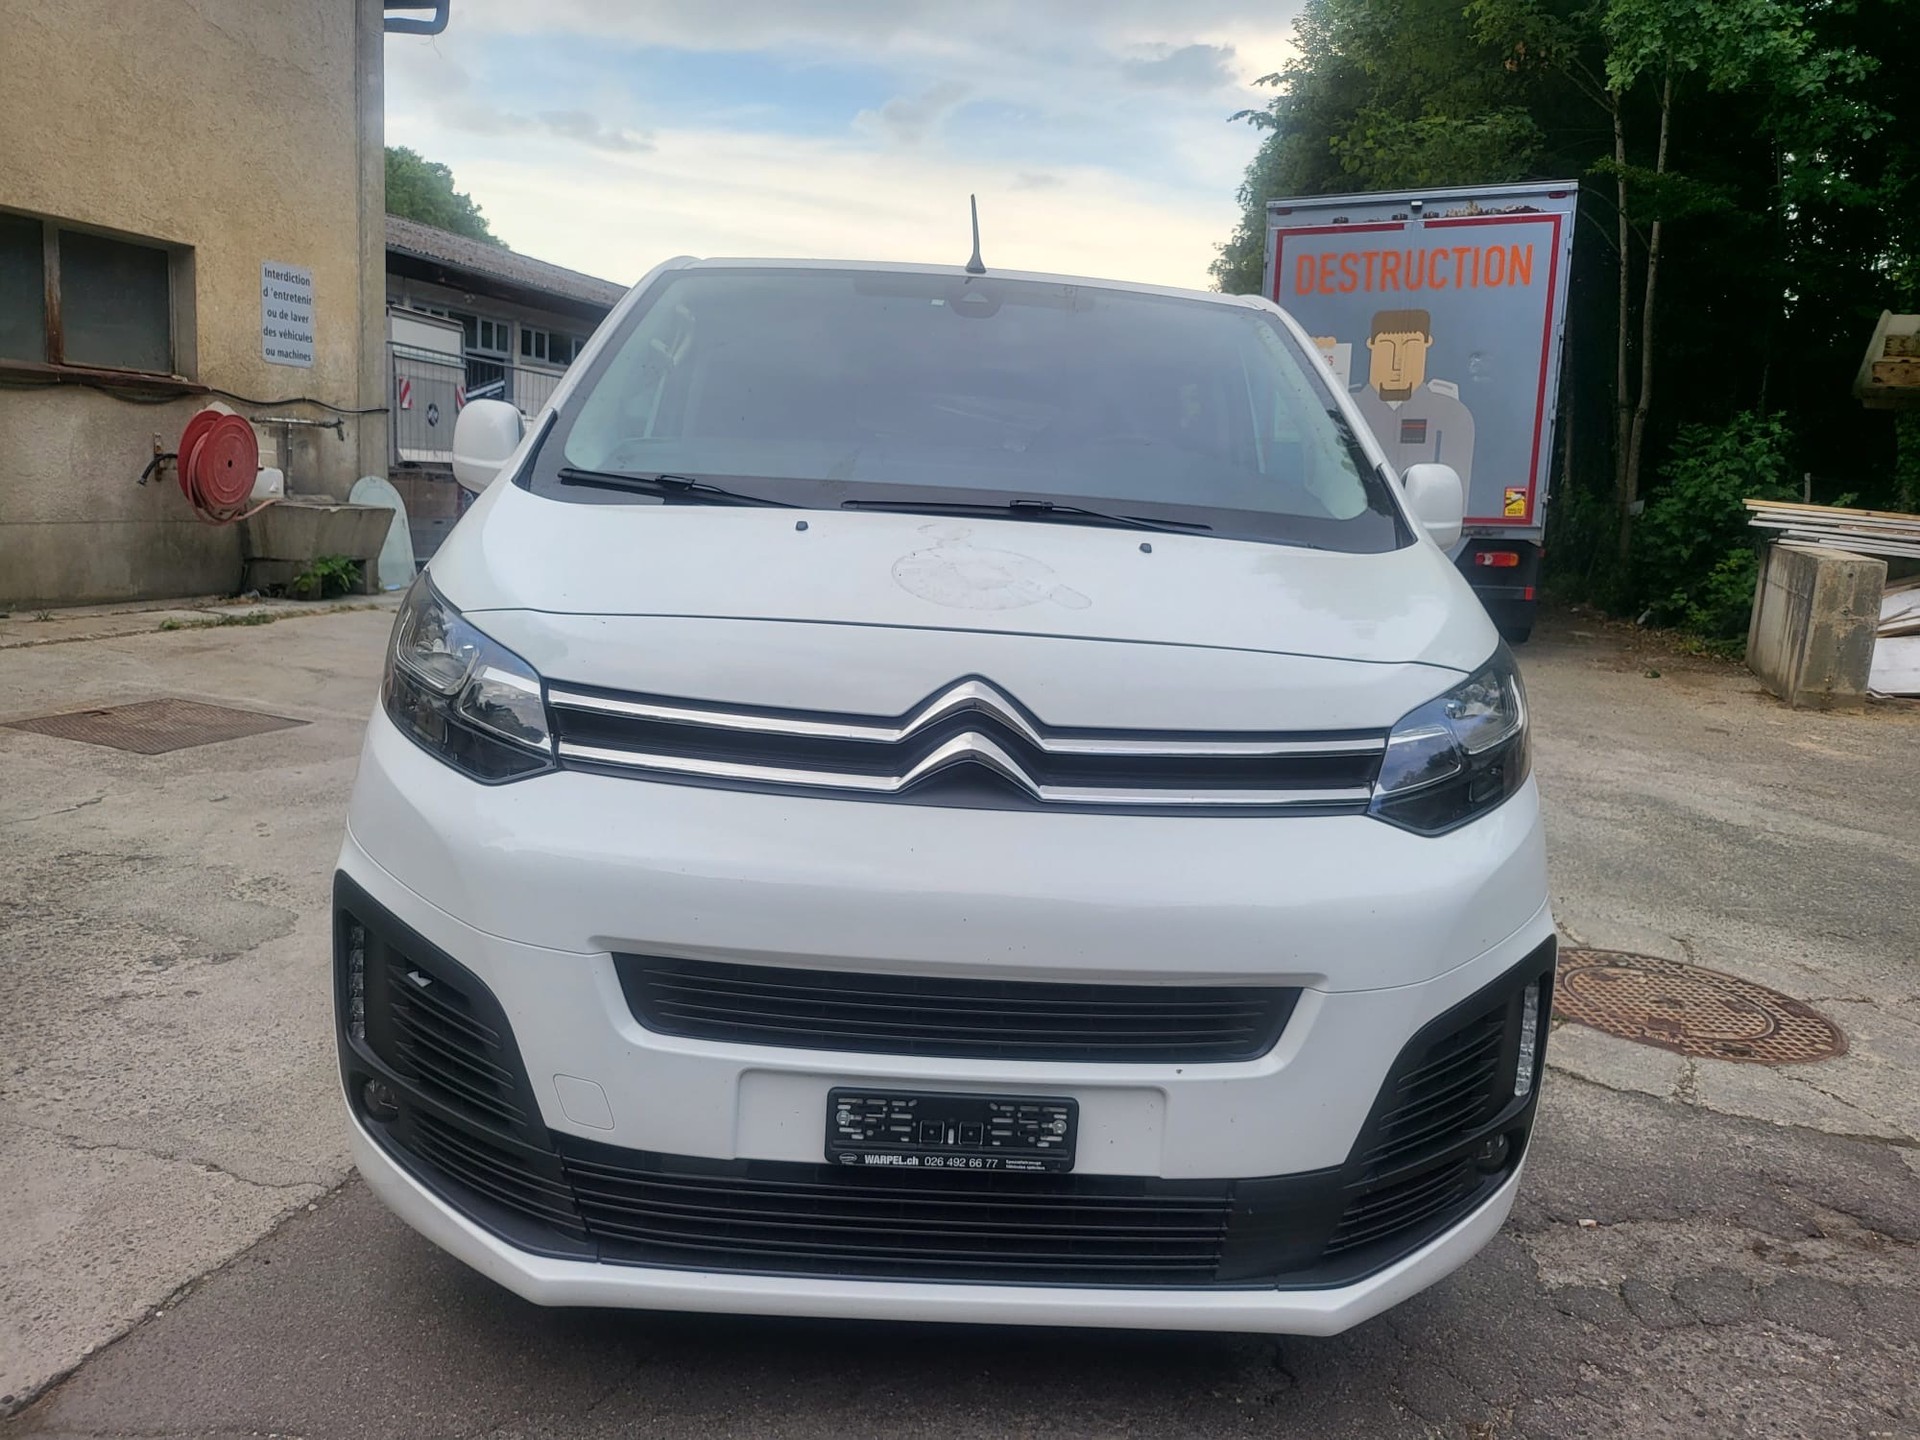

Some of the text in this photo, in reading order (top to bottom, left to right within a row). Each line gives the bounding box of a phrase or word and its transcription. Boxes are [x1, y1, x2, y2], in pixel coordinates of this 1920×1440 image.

[264, 267, 311, 286] Interdiction
[1295, 243, 1533, 295] DESTRUCTION
[267, 309, 309, 324] ou de laver
[263, 326, 313, 343] des véhicules
[265, 347, 311, 361] ou machines
[864, 1154, 919, 1165] WARPEL.ch
[924, 1156, 944, 1166] 026
[946, 1157, 966, 1167] 492
[968, 1158, 983, 1168] 66
[985, 1159, 998, 1168] 77
